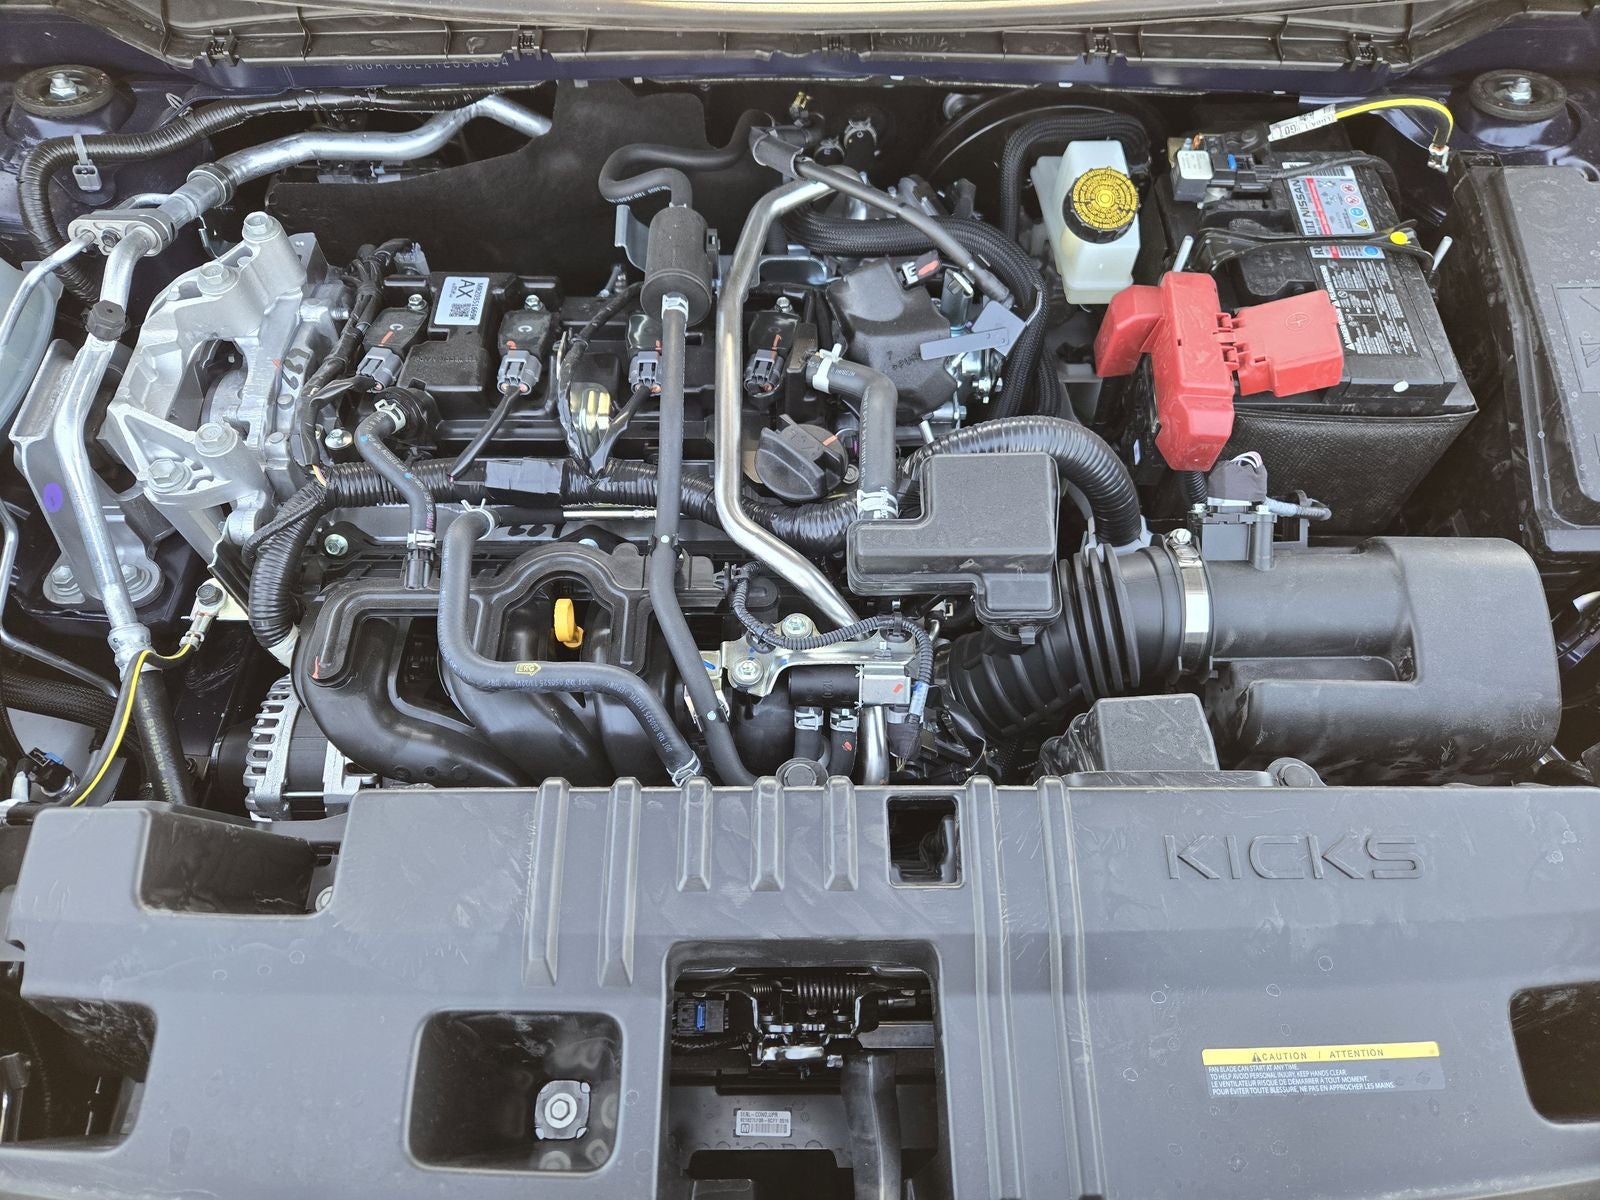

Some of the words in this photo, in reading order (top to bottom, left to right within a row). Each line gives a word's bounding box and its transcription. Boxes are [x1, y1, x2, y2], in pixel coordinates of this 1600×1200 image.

[1292, 179, 1311, 218] NISSAN
[456, 279, 475, 298] AX
[1164, 834, 1426, 880] KICKS
[1262, 1052, 1307, 1061] CAUTION
[1330, 1049, 1384, 1058] ATTENTION
